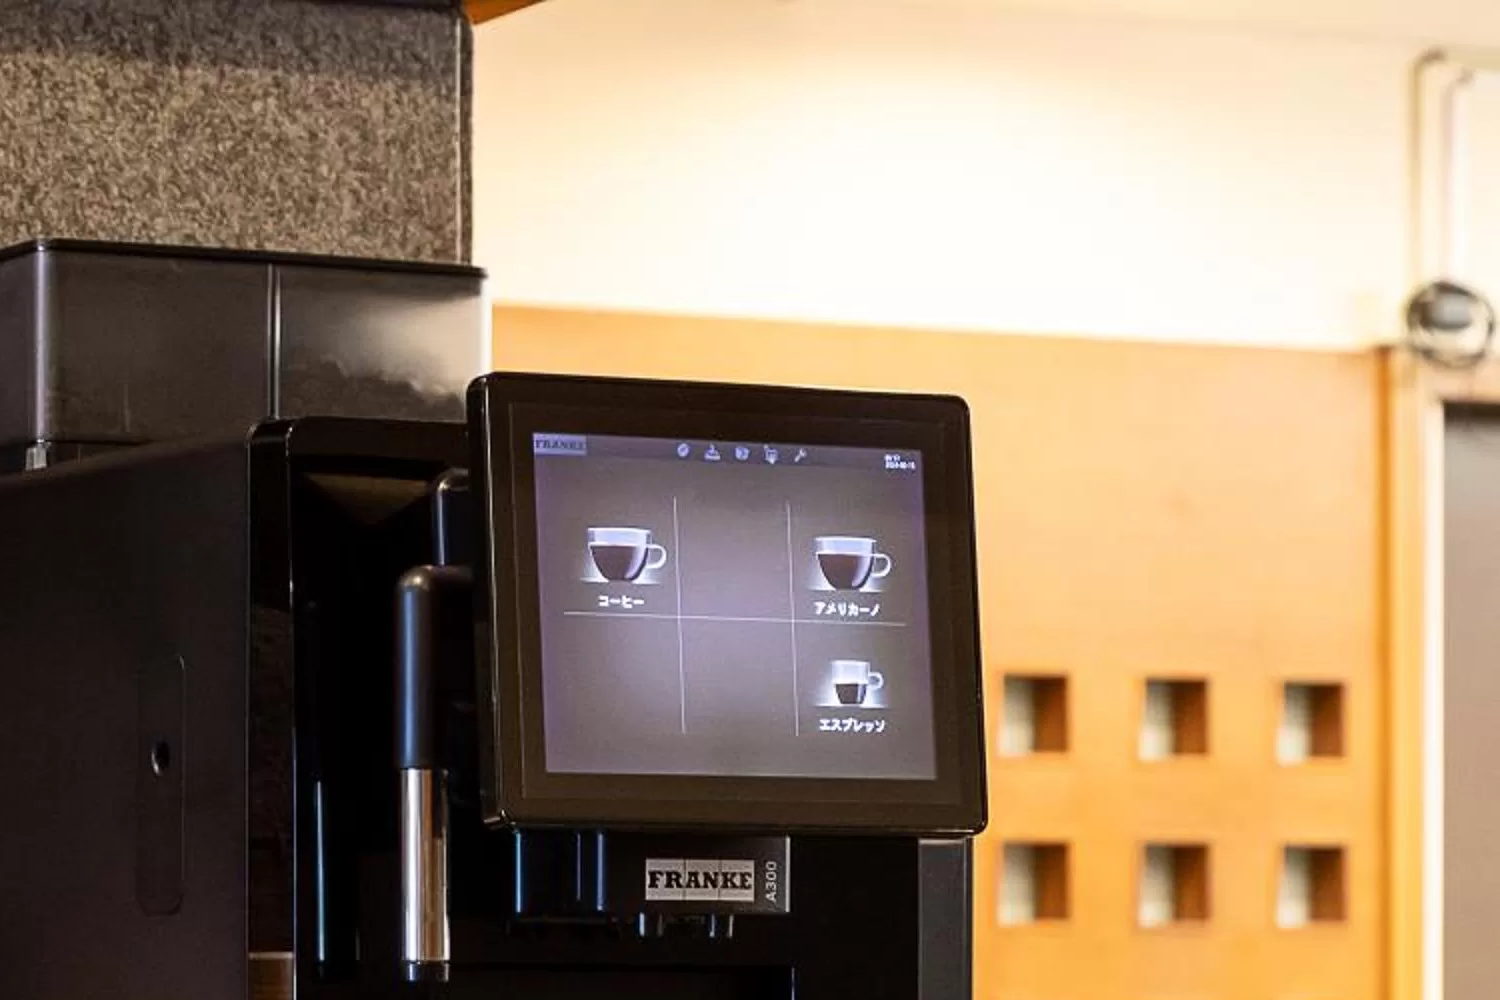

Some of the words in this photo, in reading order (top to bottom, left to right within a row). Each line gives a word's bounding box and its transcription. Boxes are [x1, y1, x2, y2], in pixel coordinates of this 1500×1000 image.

[598, 595, 645, 609] コーヒー
[814, 601, 880, 616] アメリカーノ
[819, 717, 885, 732] エスプレッソ
[648, 870, 752, 889] FRANKE
[765, 860, 777, 903] A300
